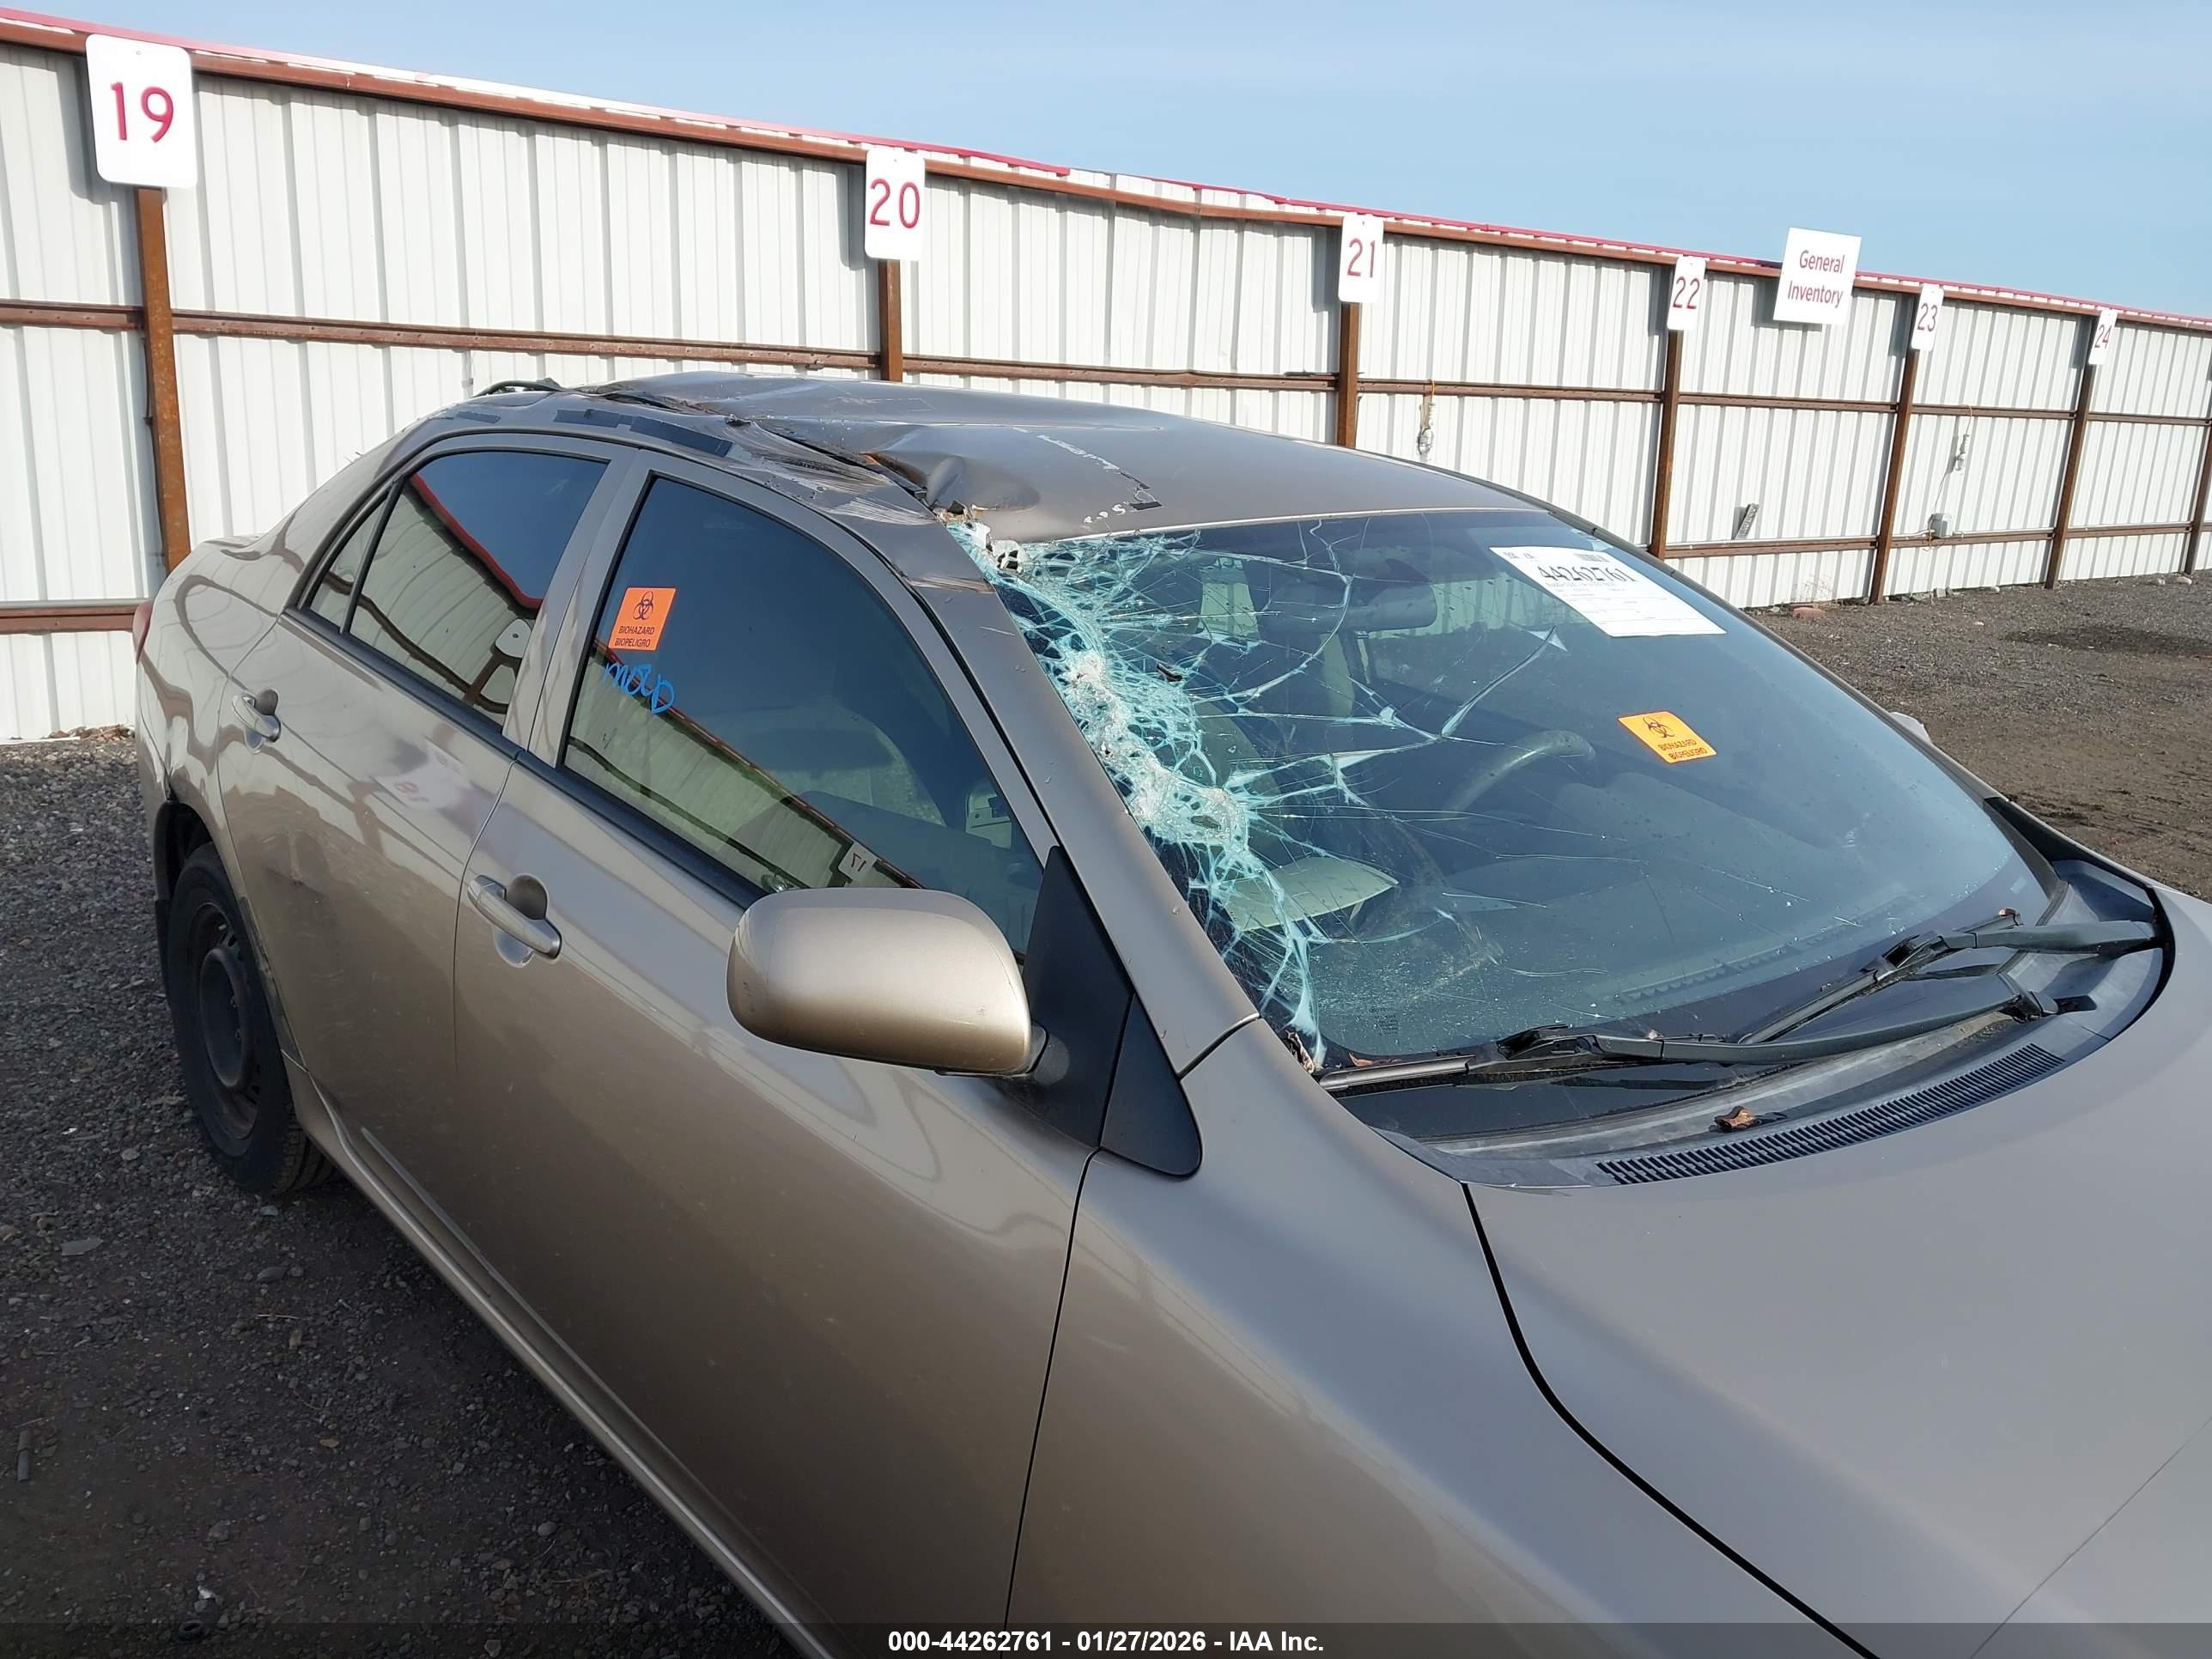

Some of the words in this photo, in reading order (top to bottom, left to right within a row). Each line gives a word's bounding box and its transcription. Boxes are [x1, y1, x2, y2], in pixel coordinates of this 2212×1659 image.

[110, 82, 173, 143] 19
[870, 178, 920, 229] 20
[1346, 238, 1376, 278] 21
[1800, 250, 1845, 274] General
[1672, 276, 1700, 310] 22
[1787, 280, 1844, 308] Inventory
[1917, 302, 1938, 332] 23
[2094, 323, 2112, 349] 24
[1537, 565, 1638, 582] 44262761
[614, 637, 651, 647] BIOPELIGRO
[618, 625, 655, 635] BIOHAZARD
